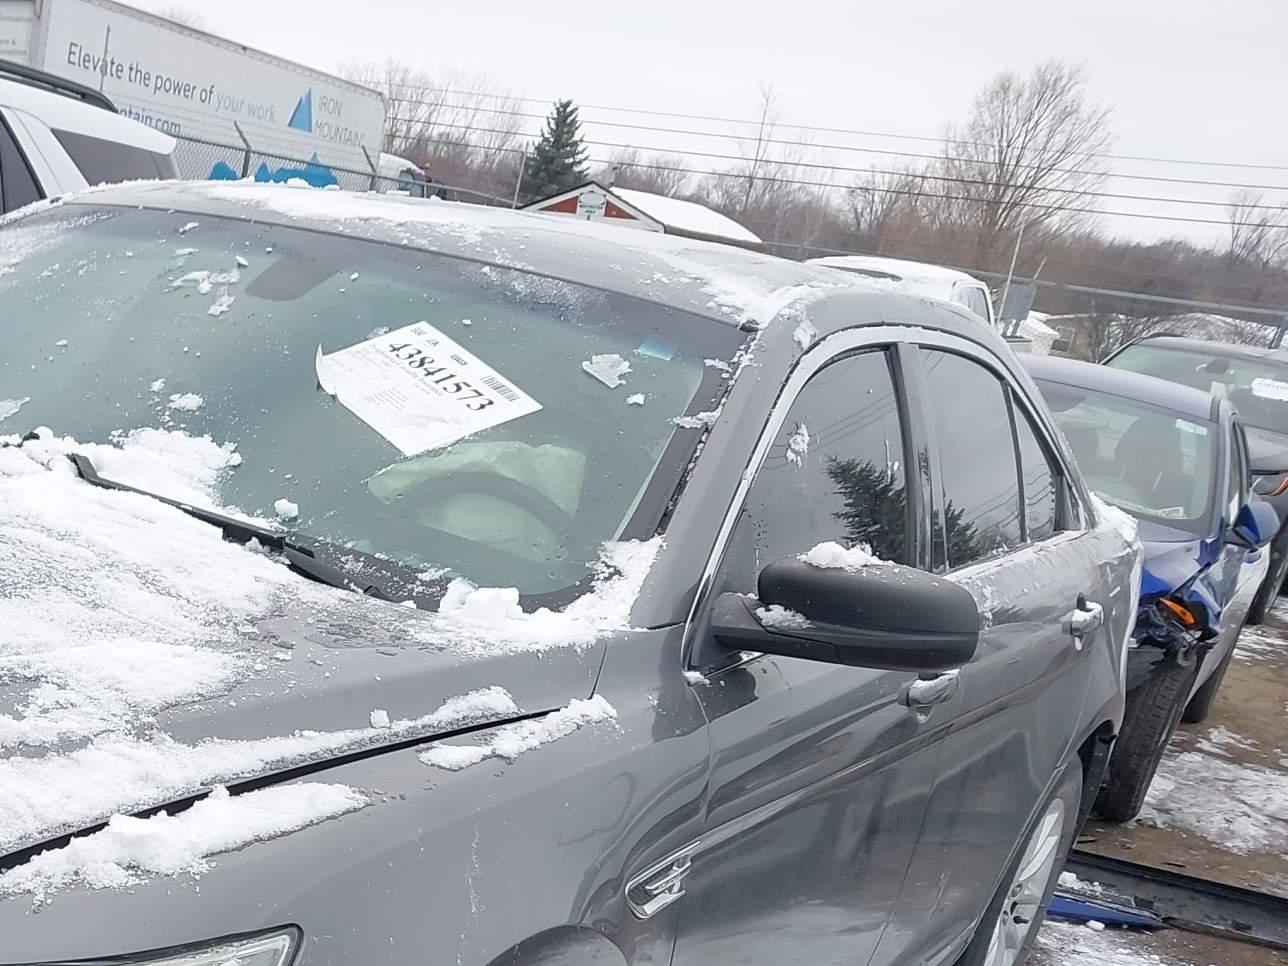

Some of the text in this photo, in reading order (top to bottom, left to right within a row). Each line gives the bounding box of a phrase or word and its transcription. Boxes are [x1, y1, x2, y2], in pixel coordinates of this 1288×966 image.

[68, 41, 124, 80] Elevate
[128, 62, 151, 87] the
[153, 74, 197, 100] power
[199, 84, 215, 105] of
[215, 92, 245, 113] your
[318, 95, 343, 117] IRON
[388, 343, 495, 411] 43841573
